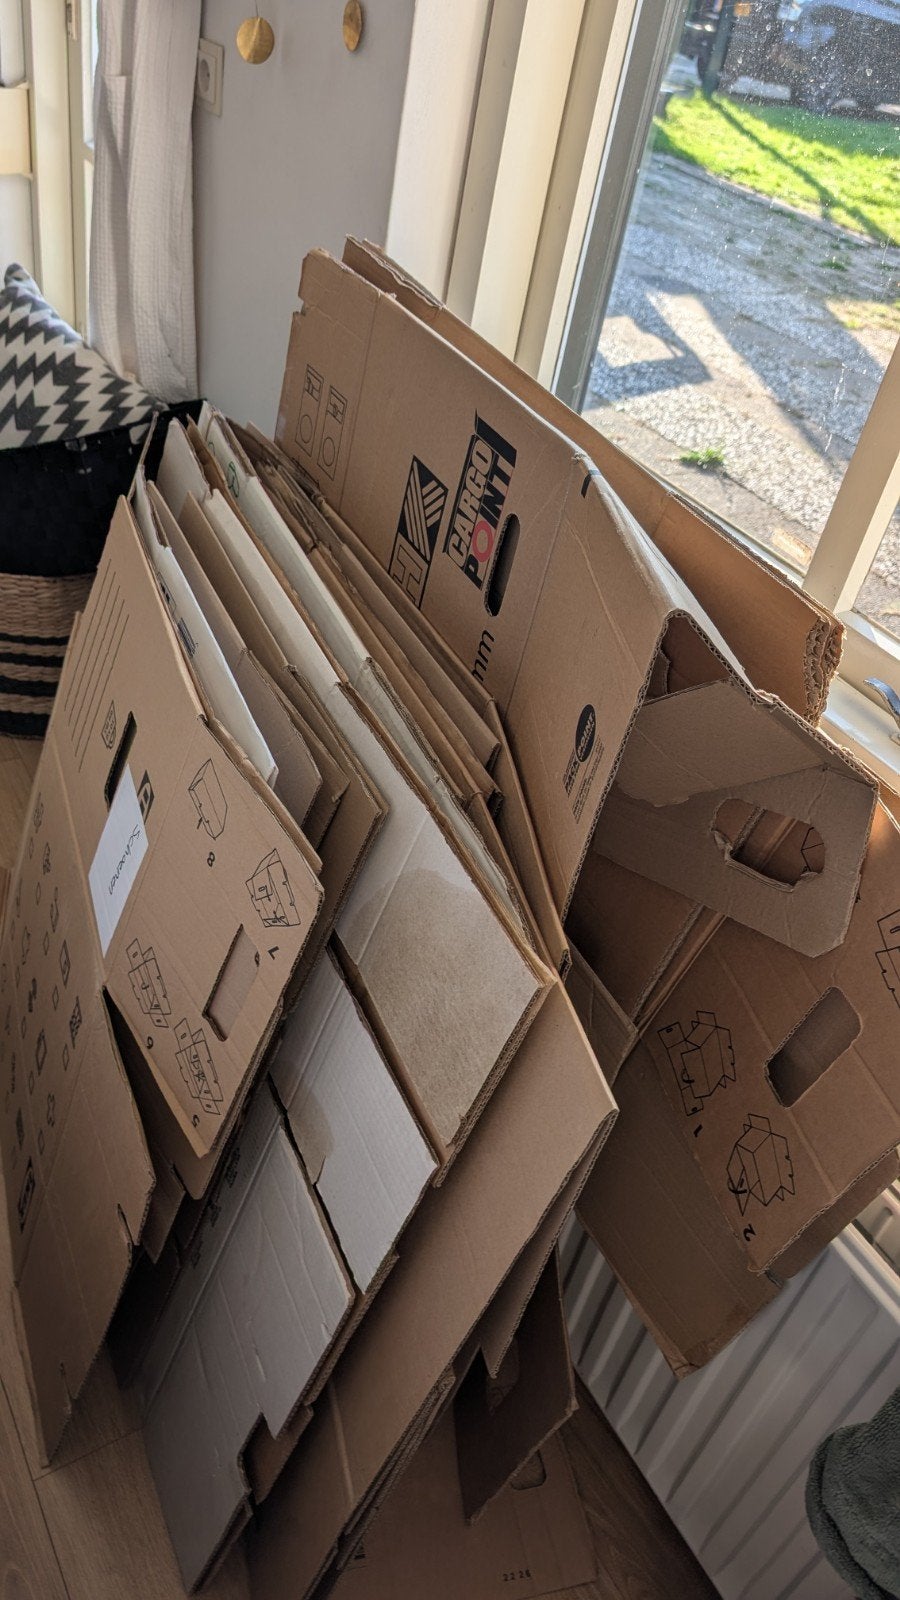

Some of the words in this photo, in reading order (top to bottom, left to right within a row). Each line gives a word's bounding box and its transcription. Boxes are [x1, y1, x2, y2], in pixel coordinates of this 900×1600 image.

[449, 439, 493, 568] CARGO
[464, 450, 515, 591] POINT
[206, 851, 216, 868] 8
[267, 946, 280, 961] 7
[191, 1114, 201, 1129] 5
[693, 1124, 704, 1138] 1
[743, 1223, 757, 1242] 2
